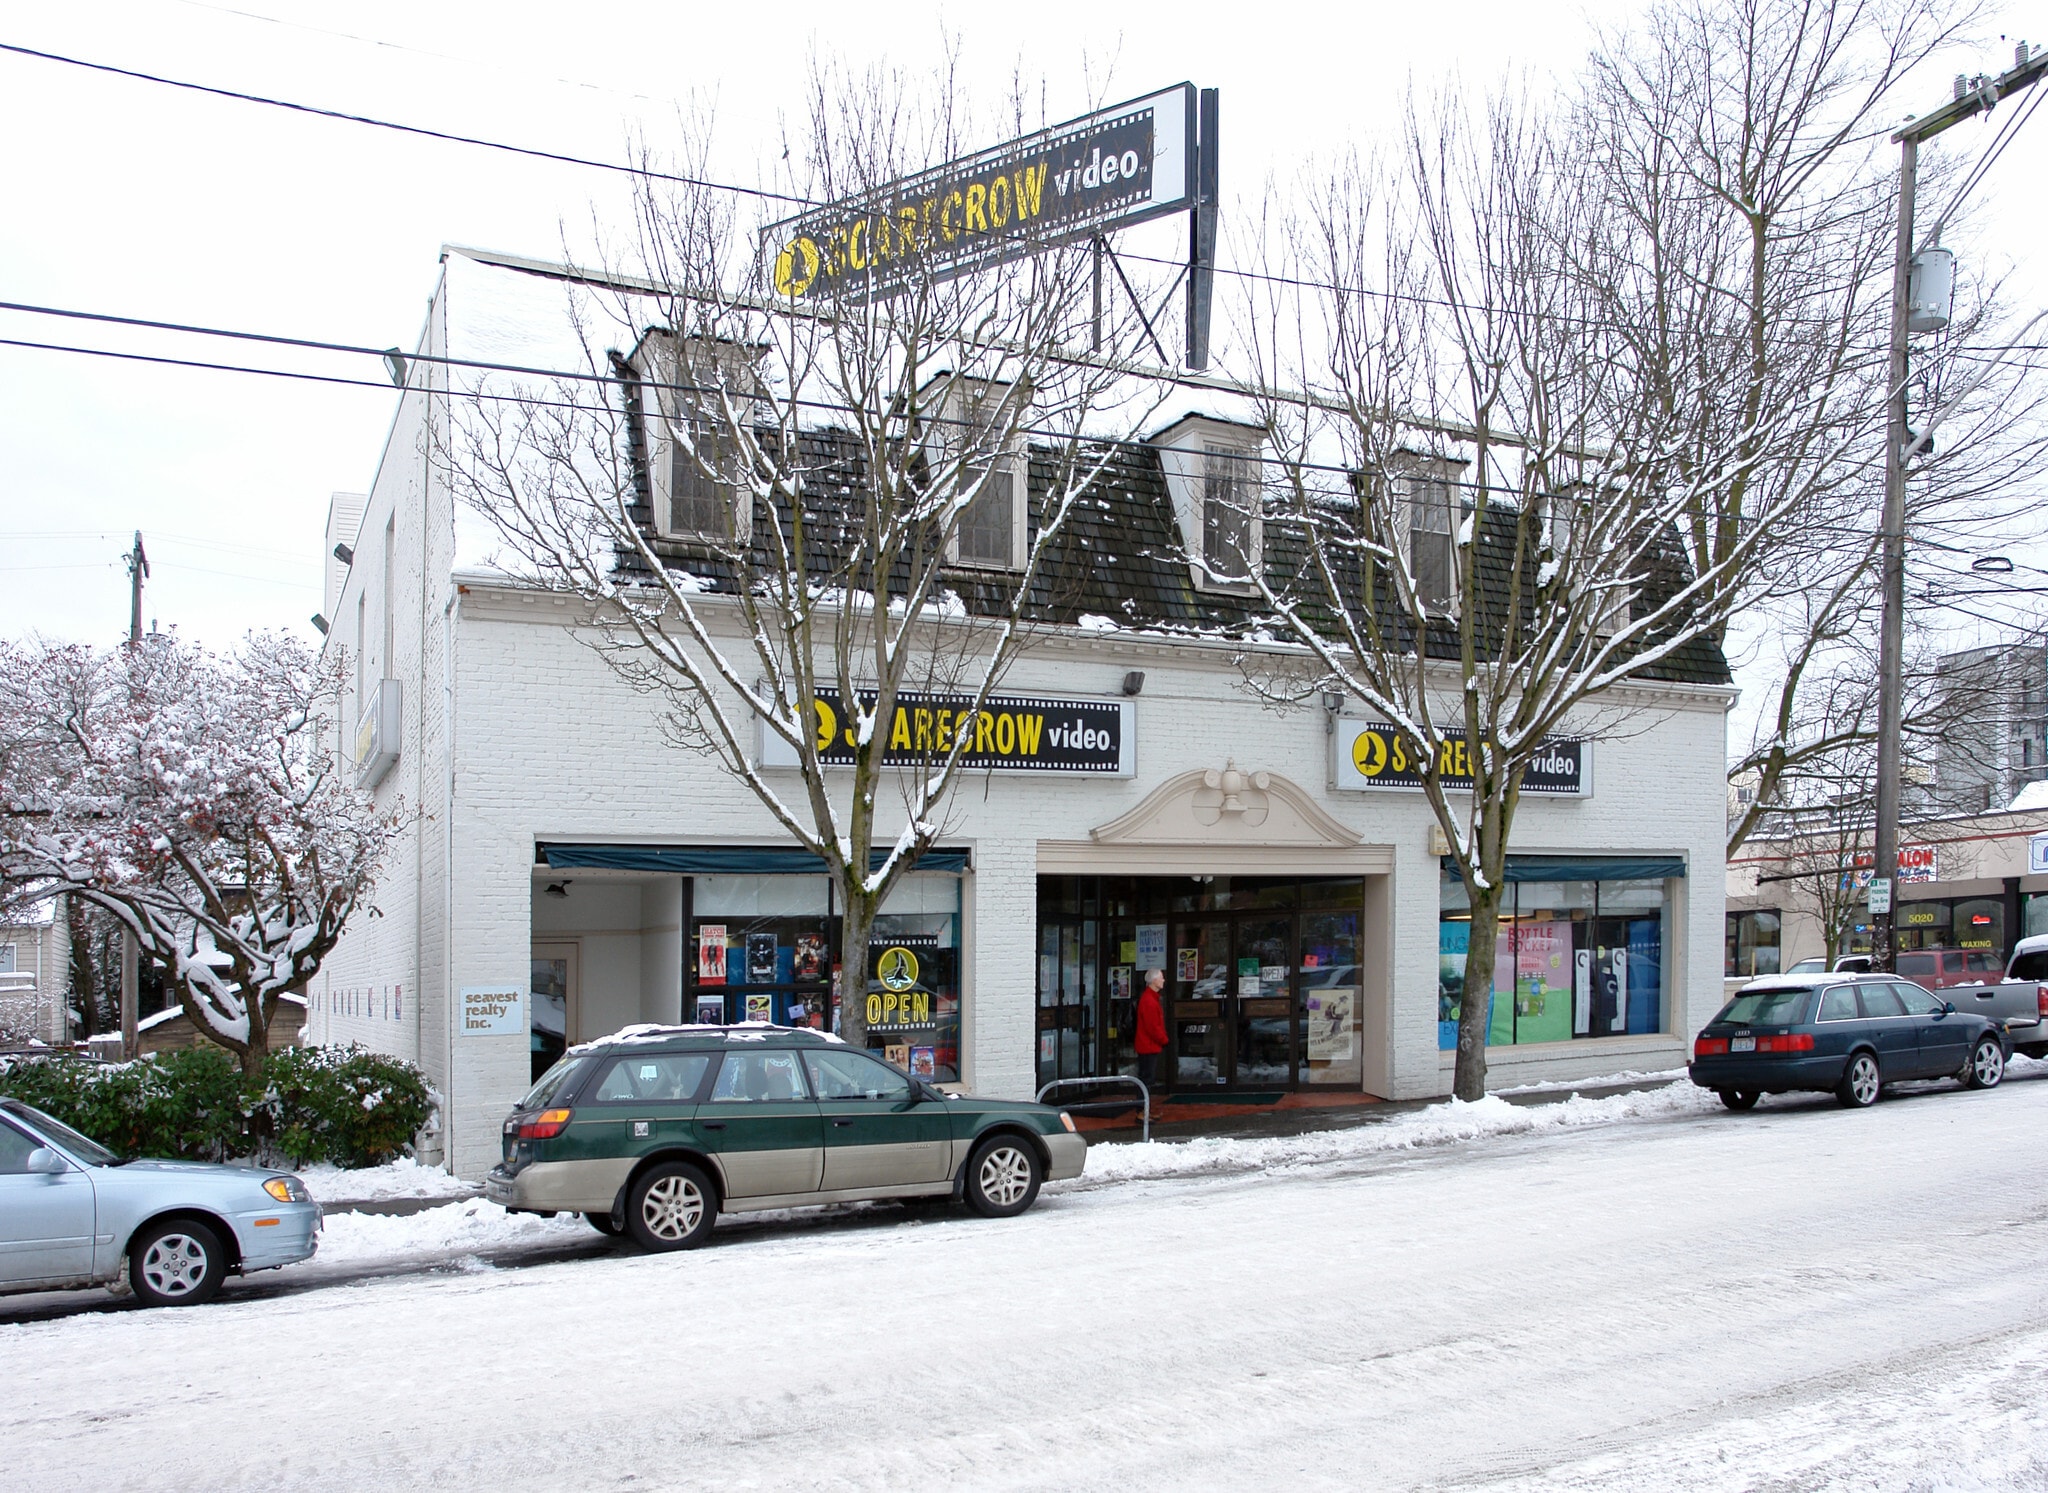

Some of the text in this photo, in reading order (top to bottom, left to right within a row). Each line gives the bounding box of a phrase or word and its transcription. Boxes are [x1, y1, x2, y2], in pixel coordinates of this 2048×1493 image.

[1054, 148, 1139, 197] video
[845, 704, 1111, 755] ARECROW video
[1532, 749, 1574, 775] video
[1897, 849, 1934, 868] ALON
[1908, 913, 1934, 923] 5020
[1508, 927, 1553, 940] BOTTLE
[1960, 940, 1992, 949] WAXING
[1263, 968, 1284, 981] OPEN
[465, 991, 518, 1003] seavest
[465, 1003, 507, 1018] realty
[867, 993, 929, 1024] OPEN
[465, 1017, 492, 1029] inc.
